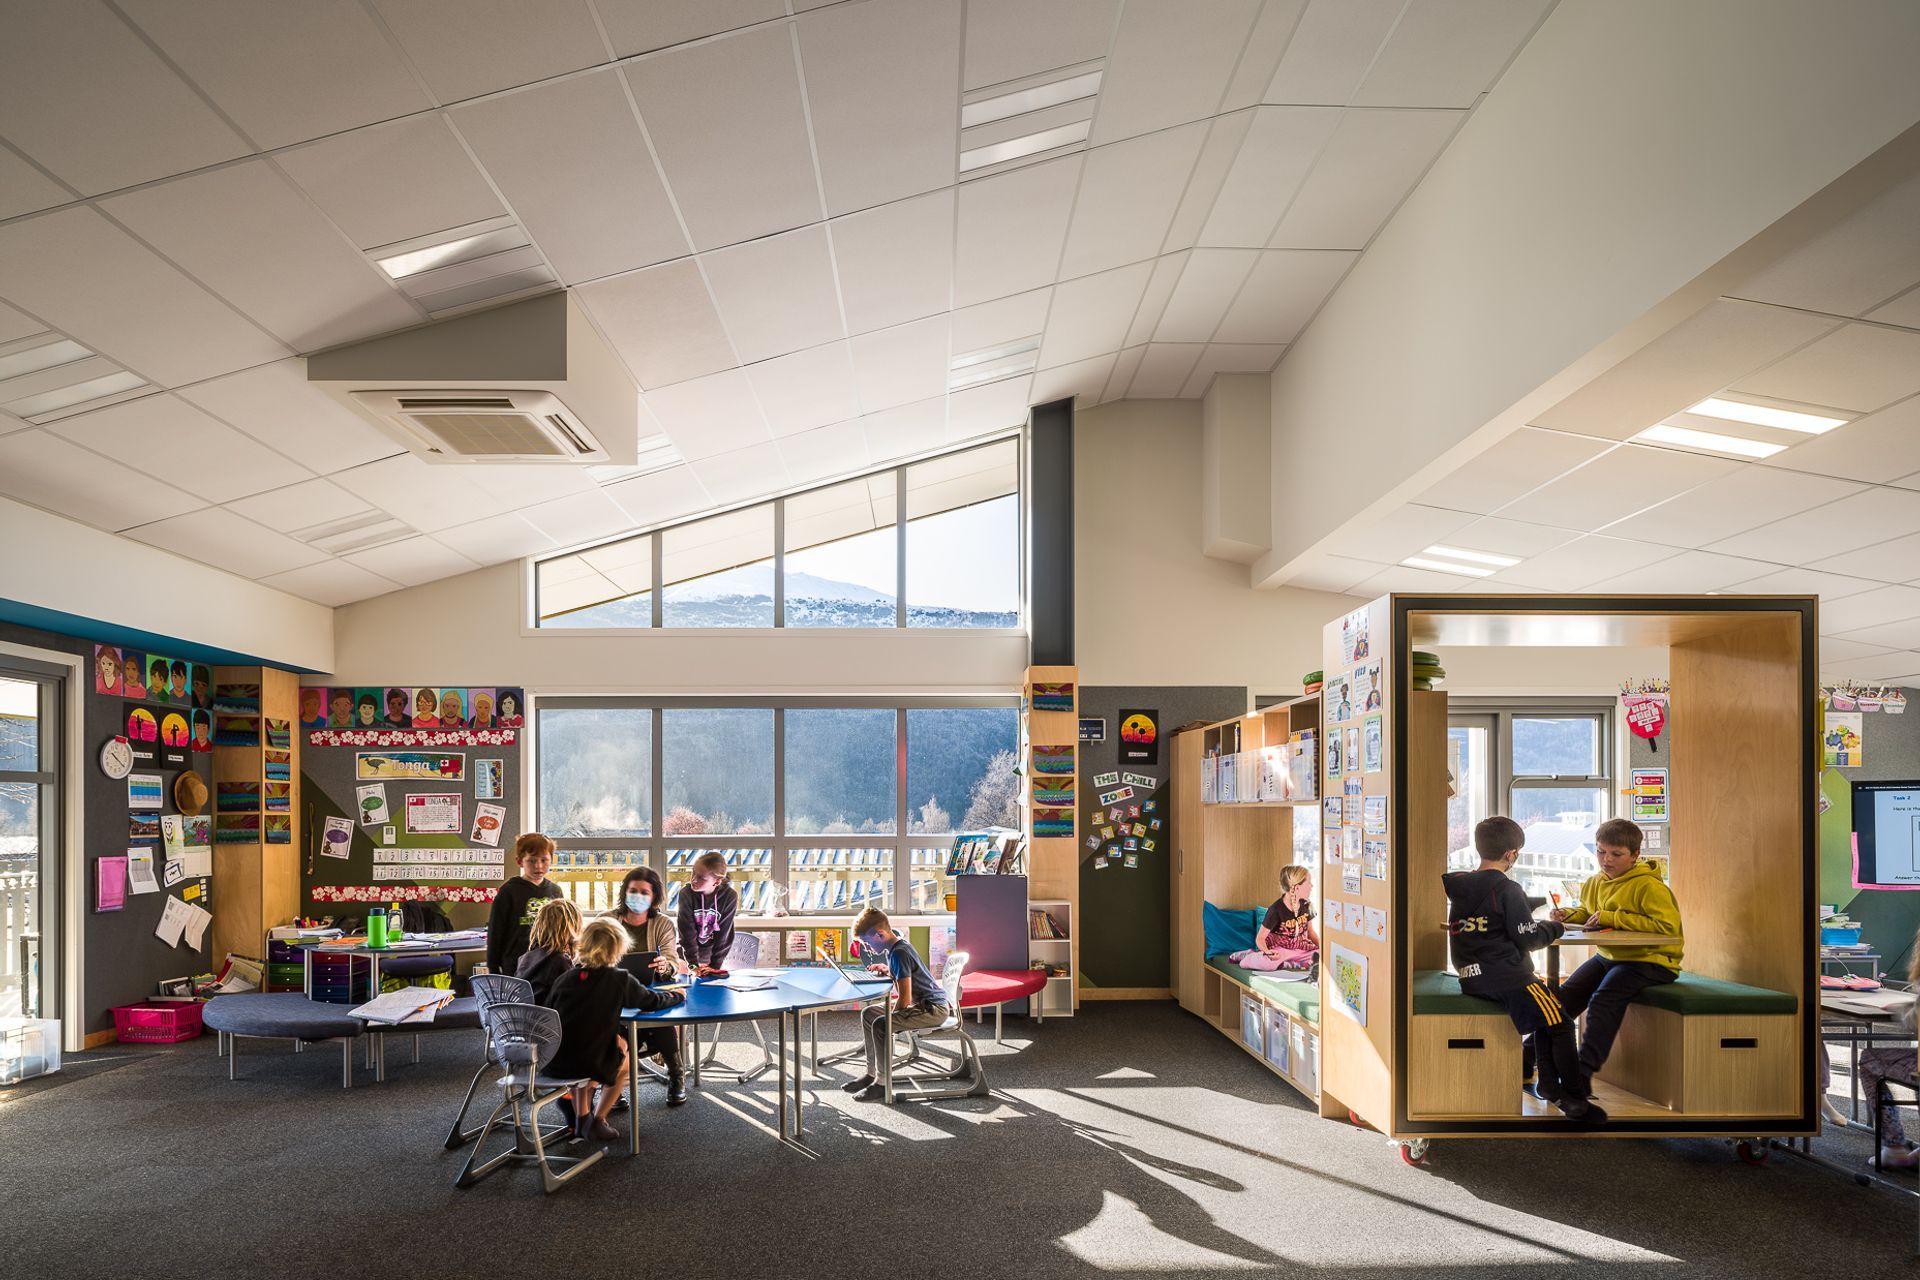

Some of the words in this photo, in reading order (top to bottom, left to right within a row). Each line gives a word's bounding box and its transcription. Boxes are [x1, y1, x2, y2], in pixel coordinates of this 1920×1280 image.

[391, 759, 430, 775] Tonga
[1124, 773, 1153, 787] CHILL
[1102, 788, 1132, 803] ZONE
